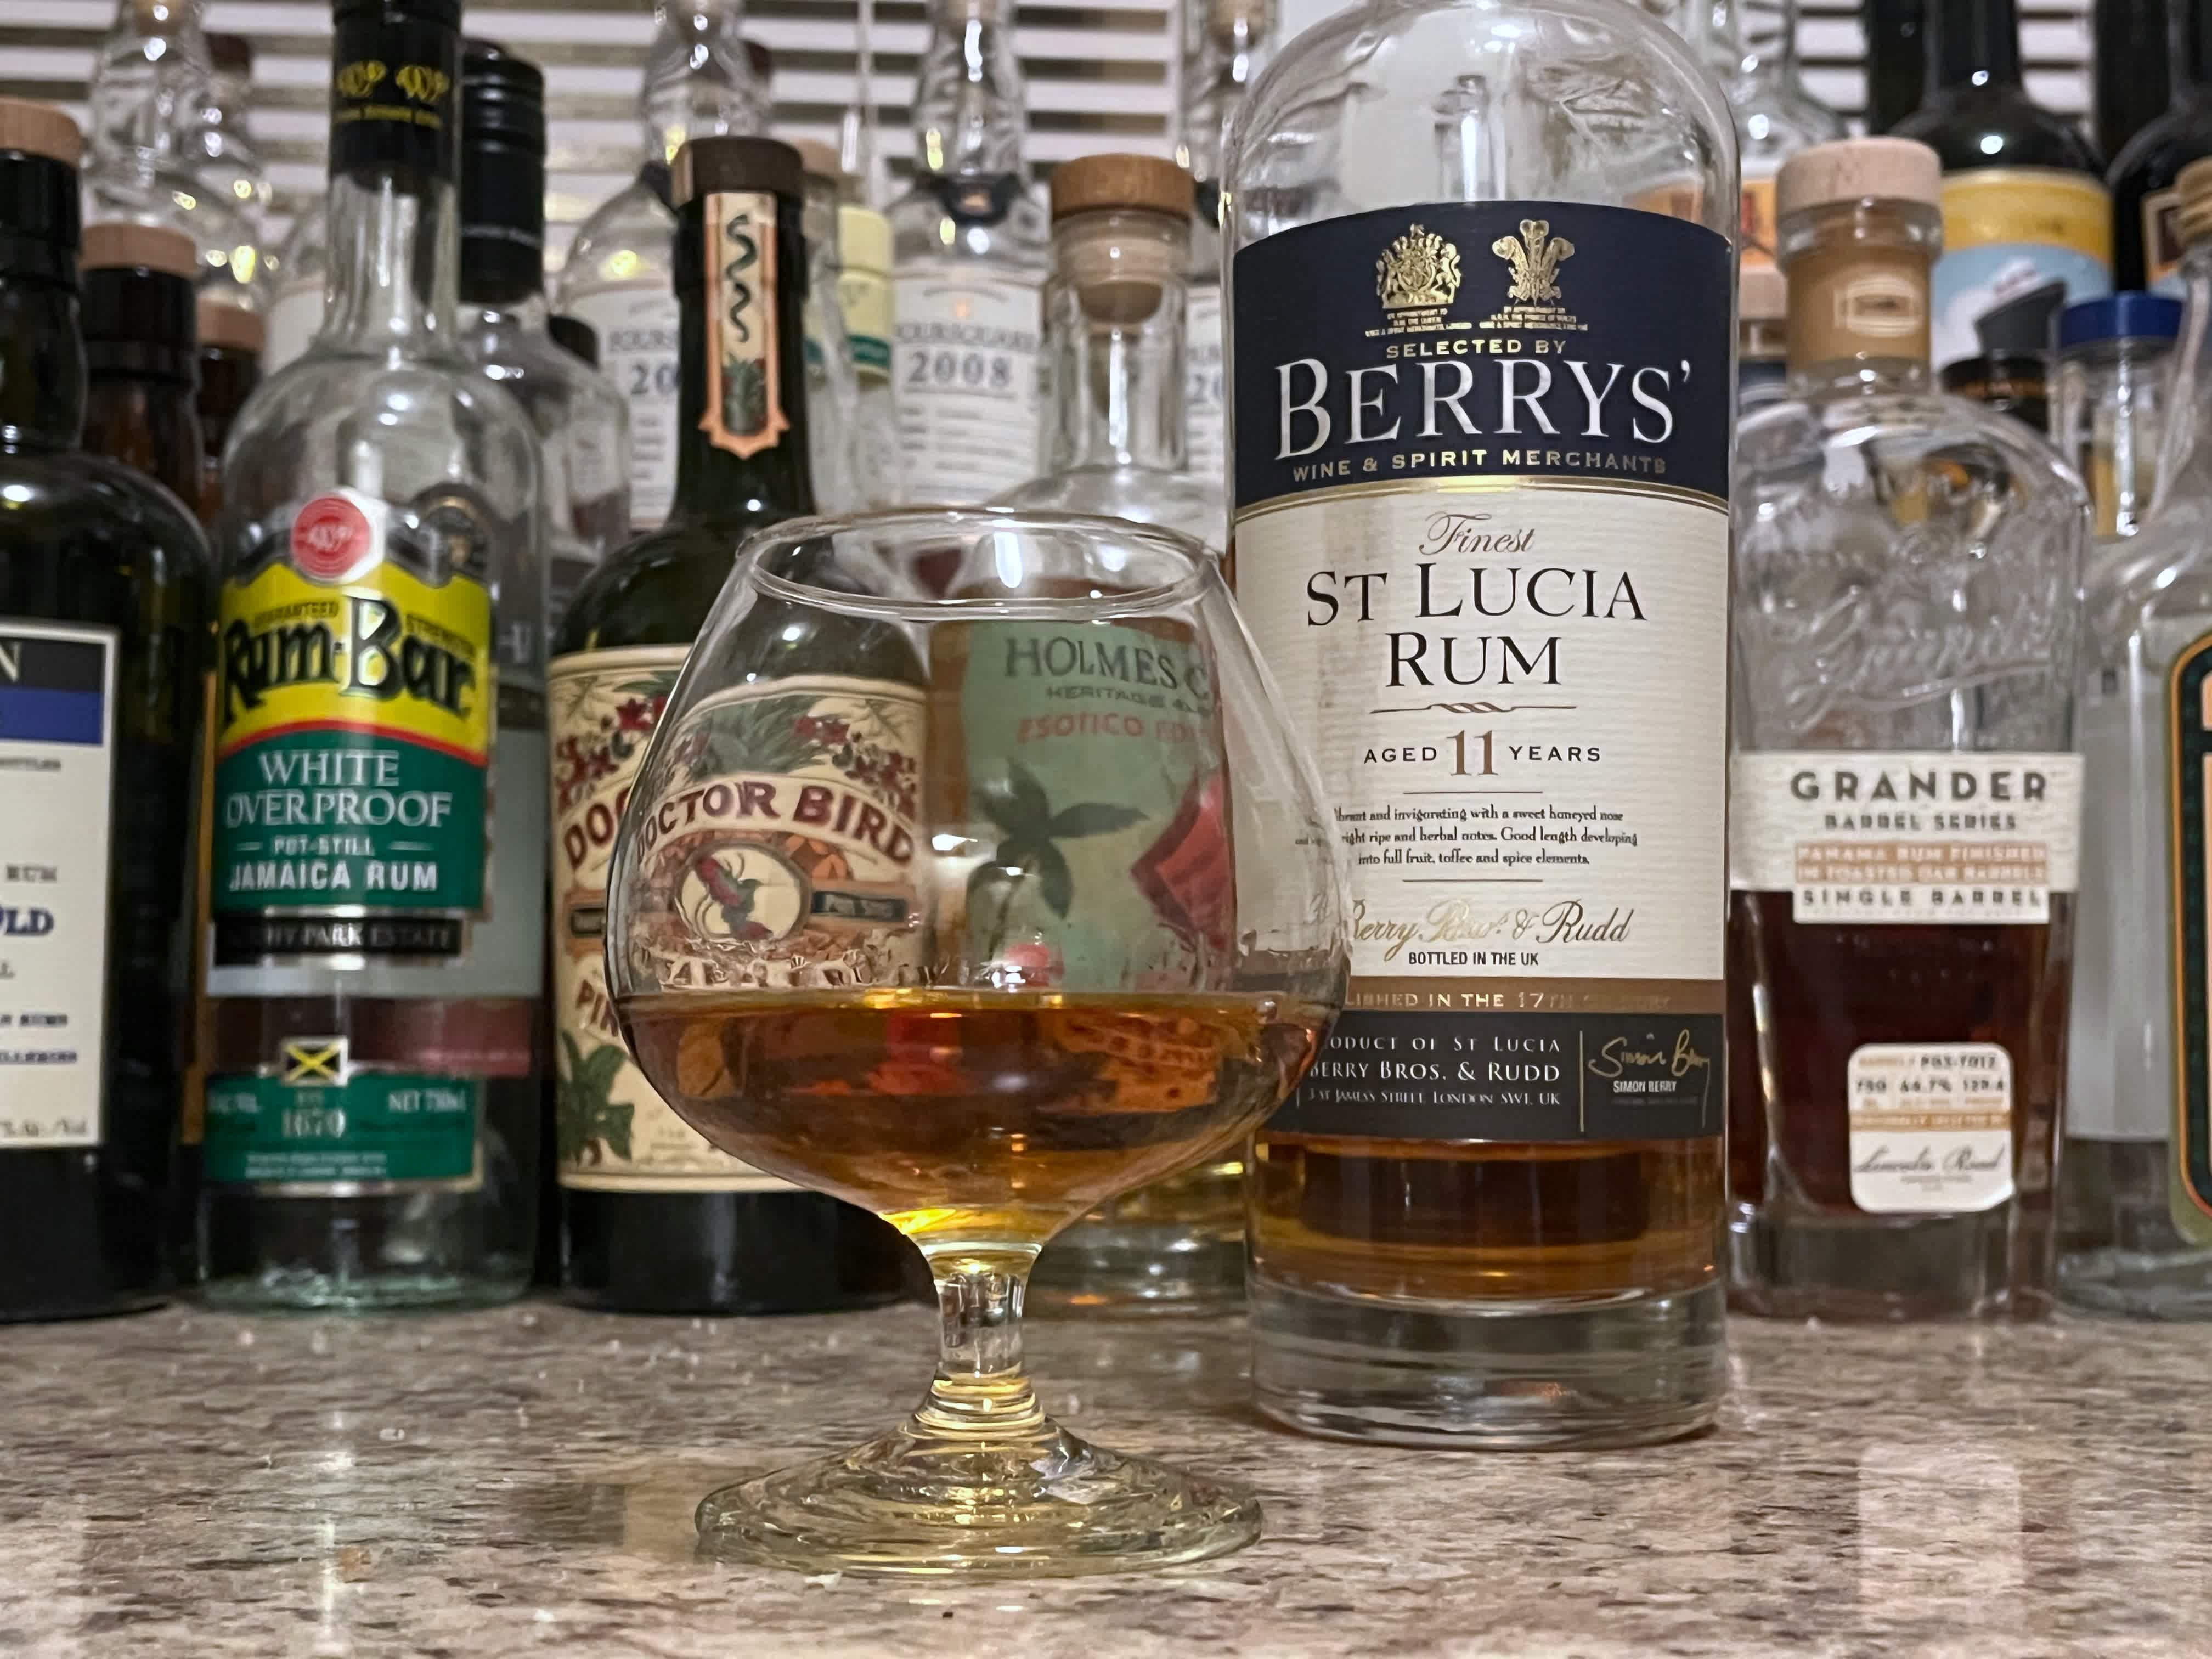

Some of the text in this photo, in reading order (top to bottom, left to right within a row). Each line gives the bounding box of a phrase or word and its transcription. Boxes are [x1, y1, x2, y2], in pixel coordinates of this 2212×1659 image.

[1386, 338, 1567, 359] SELECTED BY
[908, 350, 1011, 388] 2008
[1274, 357, 1691, 461] BERRYS'
[1293, 448, 1667, 484] WINE & SPIRIT MERCHANTS
[1419, 511, 1536, 556] Finest
[1306, 562, 1649, 627] ST LUCIA
[1004, 635, 1178, 690] HOLMES
[1384, 631, 1562, 688] RUM
[258, 749, 399, 787] WHITE
[1363, 730, 1601, 775] AGED 11 YEARS
[1790, 771, 2047, 802] GRANDER
[225, 789, 454, 828] OVERPROOF
[637, 780, 913, 867] DOCTOR BIRD
[1334, 803, 1624, 823] brant and invigorating with a sweet honeyed nose
[1824, 813, 2017, 831] BARREL SERIES
[272, 835, 376, 856] POT-STILL
[1369, 831, 1391, 846] ripe
[1394, 826, 1416, 842] and
[1420, 825, 1458, 842] herbal
[1500, 826, 1537, 842] Good
[1540, 826, 1577, 844] length
[1581, 826, 1638, 847] developing
[1358, 853, 1380, 865] into
[1384, 849, 1402, 864] full
[1439, 848, 1474, 864] toffee
[1476, 848, 1499, 864] and
[1502, 852, 1532, 867] spice
[1896, 845, 1943, 862] RUM
[228, 860, 438, 892] JAMAICA RUM
[1803, 889, 2040, 907] SINGLE BARREL
[0, 903, 54, 937] LD
[1536, 898, 1635, 944] Rudd
[1408, 952, 1539, 966] BOTTLED IN THE UK
[1429, 993, 1452, 1007] IN
[1461, 993, 1504, 1007] THE
[1327, 1036, 1397, 1050] ODUCT
[1454, 1035, 1479, 1051] ST
[1494, 1036, 1560, 1052] LUCIA
[1380, 1060, 1447, 1080] BROS.
[1457, 1061, 1476, 1080] &
[1488, 1061, 1560, 1081] RUDD
[1433, 1090, 1493, 1104] LONDON
[1539, 1092, 1561, 1105] UK
[1613, 1080, 1677, 1093] SIMON BERRY
